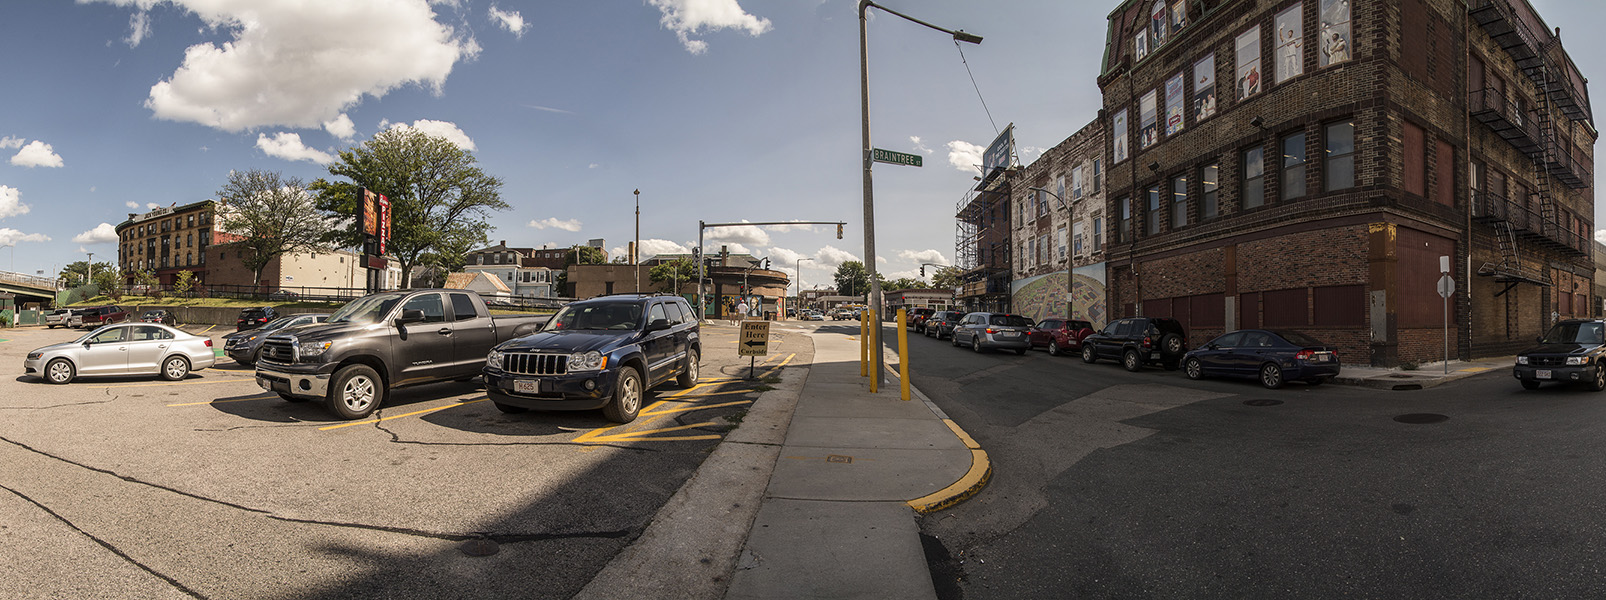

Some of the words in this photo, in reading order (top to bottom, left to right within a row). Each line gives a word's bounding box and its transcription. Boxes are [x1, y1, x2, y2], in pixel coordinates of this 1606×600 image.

[874, 149, 914, 165] BRAINTREE
[744, 323, 767, 331] Enter
[746, 331, 765, 339] Here
